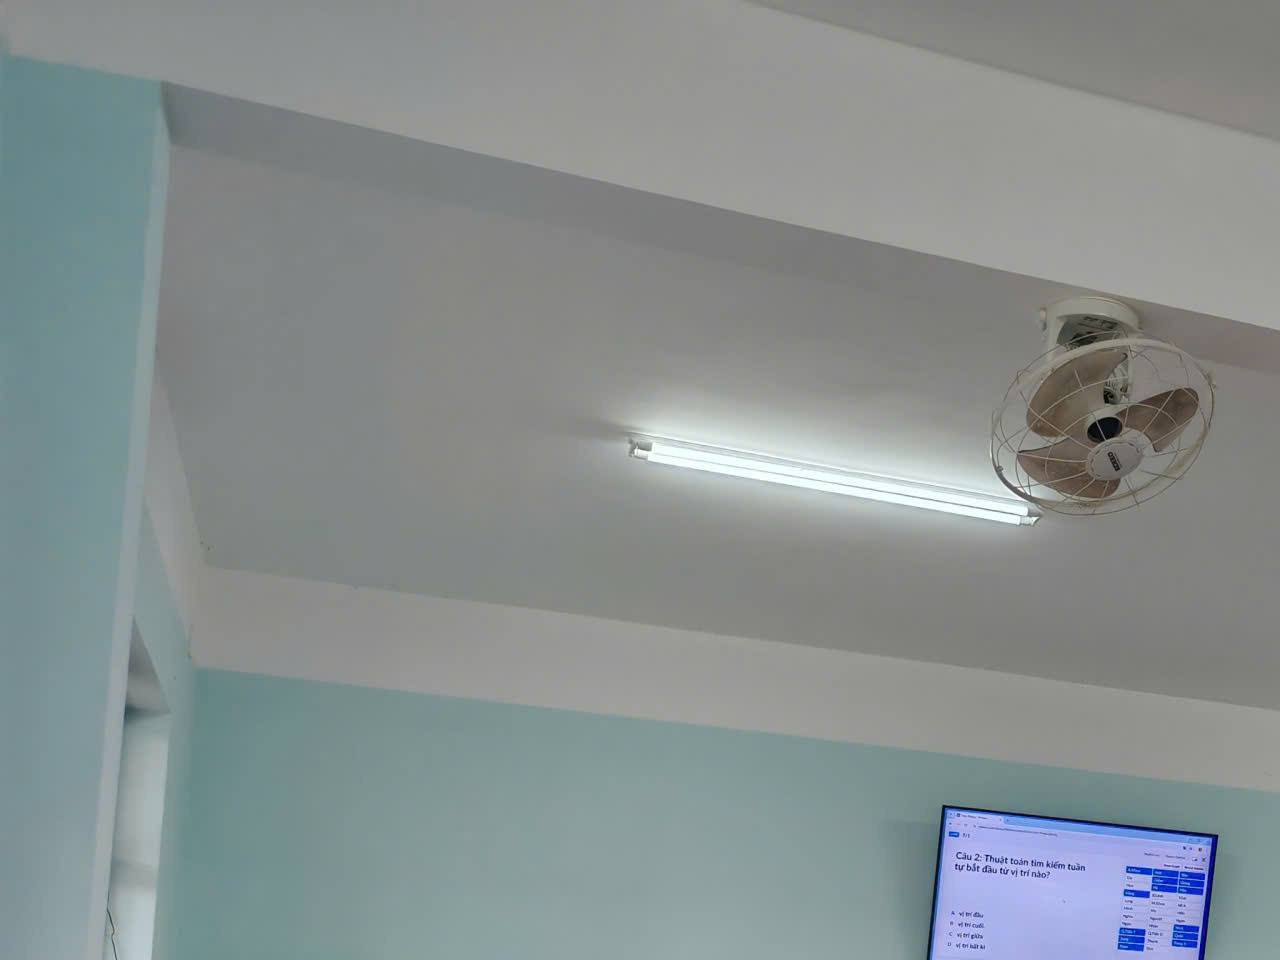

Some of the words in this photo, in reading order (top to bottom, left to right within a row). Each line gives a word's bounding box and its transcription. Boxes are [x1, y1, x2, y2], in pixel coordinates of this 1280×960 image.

[955, 851, 972, 861] Câu
[974, 854, 982, 862] 2:
[984, 854, 1008, 866] Thuật
[1010, 857, 1029, 866] toán
[1046, 860, 1066, 870] kiếm
[966, 863, 980, 872] bắt
[982, 864, 998, 874] đầu
[1010, 868, 1018, 878] vị
[1020, 868, 1030, 878] trí
[1031, 870, 1051, 879] nào?
